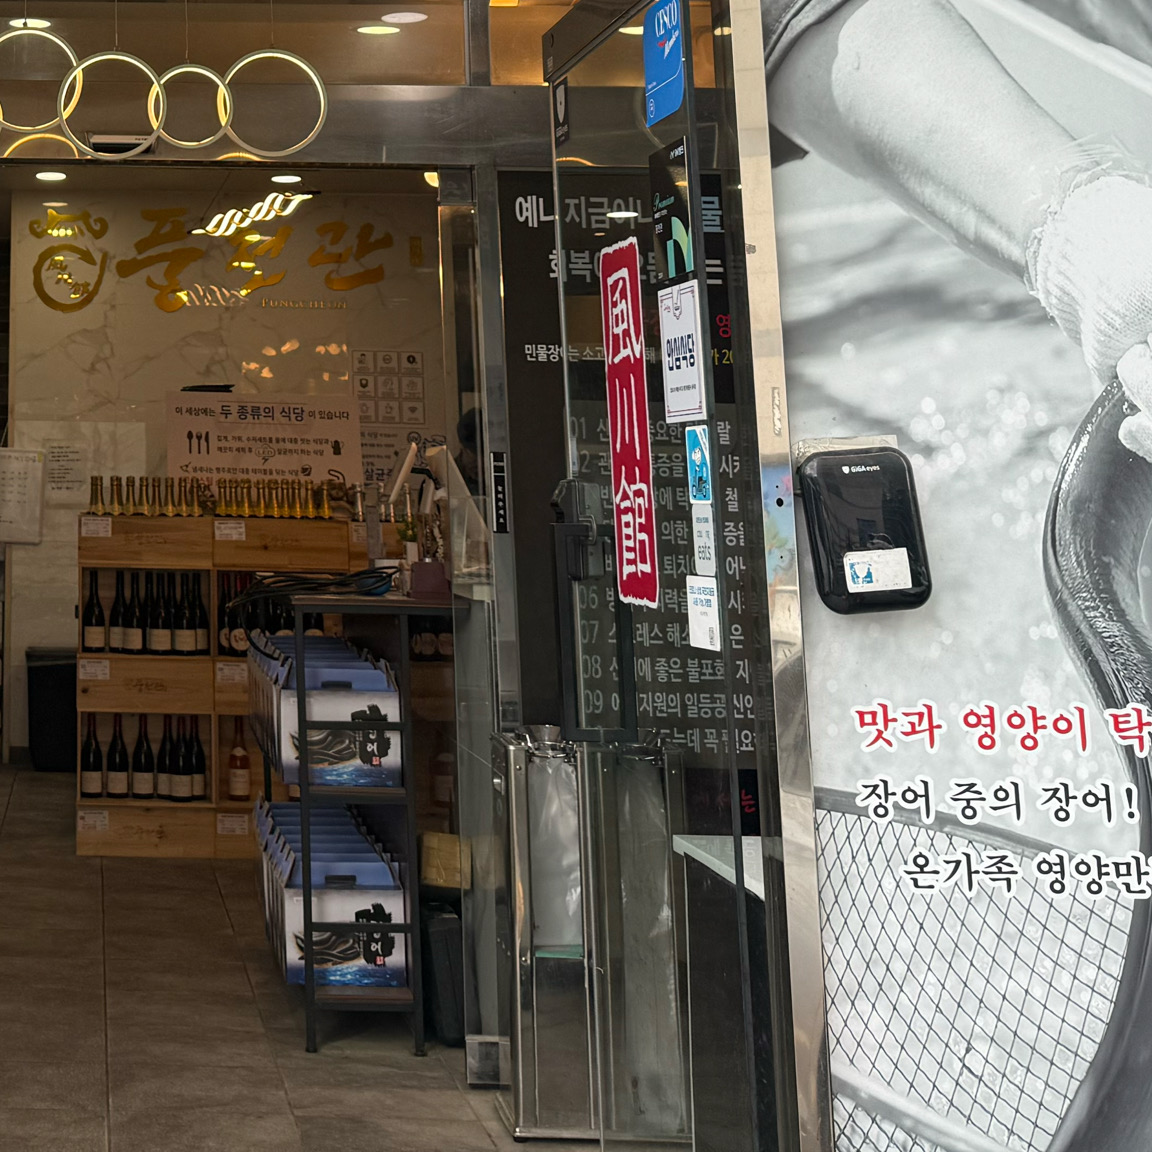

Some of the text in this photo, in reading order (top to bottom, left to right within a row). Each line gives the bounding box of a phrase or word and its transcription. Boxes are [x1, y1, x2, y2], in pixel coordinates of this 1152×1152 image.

[666, 333, 696, 371] 안심식당
[220, 405, 233, 420] 두
[236, 405, 275, 421] 종류의
[279, 406, 305, 422] 식당
[318, 410, 350, 421] 있습니다
[655, 657, 683, 683] 좋은
[857, 703, 941, 747] 맛과
[963, 706, 1086, 750] 영양이
[860, 778, 1140, 824] 장어 중의 장어!
[904, 852, 1019, 894] 온가족
